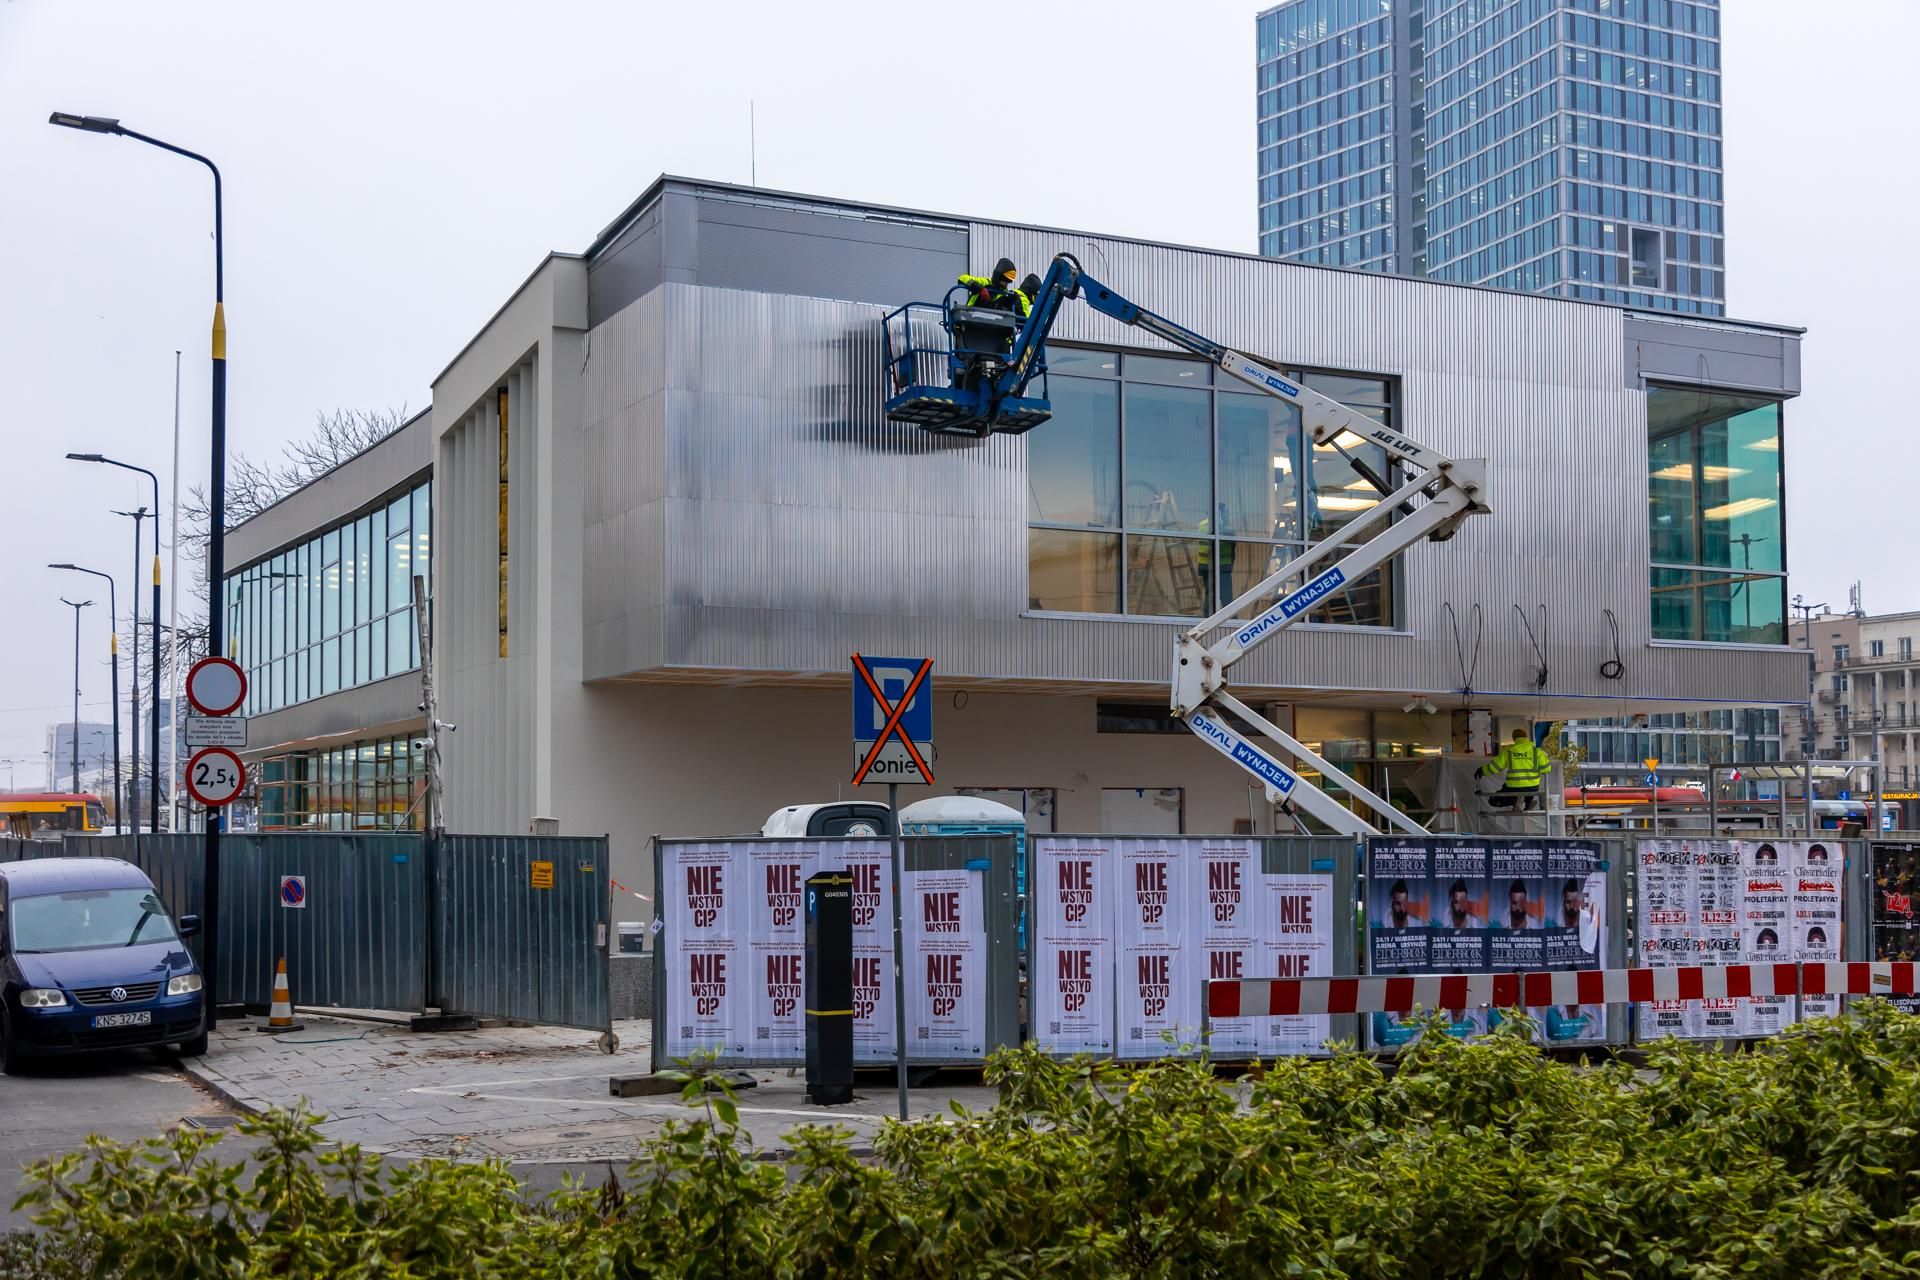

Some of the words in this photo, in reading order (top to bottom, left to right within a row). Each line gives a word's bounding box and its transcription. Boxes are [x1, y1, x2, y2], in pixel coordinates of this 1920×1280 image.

[1243, 366, 1266, 381] DRIAL
[1267, 376, 1298, 397] WYNAJEM
[1371, 430, 1394, 443] JLG
[1393, 440, 1422, 457] LIFT
[1240, 612, 1282, 644] DRIAL
[1284, 572, 1340, 613] WYNAJEM
[873, 666, 915, 729] P
[1192, 715, 1231, 749] DRIAL
[1237, 746, 1290, 788] WYNAJEM
[687, 866, 722, 895] NIE
[766, 864, 801, 893] NIE
[847, 864, 880, 892] NIE
[1059, 862, 1092, 890] NIE
[1136, 863, 1168, 891] NIE
[1209, 862, 1240, 890] NIE
[688, 896, 722, 909] WSTYD
[768, 894, 800, 908] WSTYD
[852, 894, 880, 907] STYD
[1060, 891, 1092, 903] WSTYD
[1137, 892, 1168, 904] WSTYD
[1210, 891, 1240, 903] WSTYD
[924, 892, 960, 922] NIE
[1066, 904, 1086, 922] CI?
[1142, 905, 1162, 922] CI?
[1215, 904, 1235, 922] CI?
[1280, 896, 1312, 924] NIE
[694, 909, 716, 928] CI?
[773, 908, 796, 926] CI?
[852, 908, 874, 926] CI?
[690, 954, 726, 983] NIE
[767, 955, 802, 984] NIE
[852, 958, 880, 987] NIE
[928, 955, 962, 984] NIE
[1058, 950, 1092, 979] NIE
[1138, 956, 1170, 984] NIE
[1210, 952, 1242, 978] NIE
[1278, 955, 1310, 977] NIE
[692, 984, 726, 996] WSTYD
[768, 985, 800, 998] WSTYD
[852, 988, 880, 1000] STYD
[928, 985, 962, 998] WSTYD
[1059, 980, 1091, 992] WSTYD
[1140, 985, 1169, 998] WSTYD
[697, 998, 720, 1016] CI?
[774, 999, 796, 1016] CI?
[852, 1002, 874, 1019] CI?
[933, 998, 955, 1016] CI?
[1064, 994, 1085, 1012] CI?
[1144, 999, 1165, 1016] CI?
